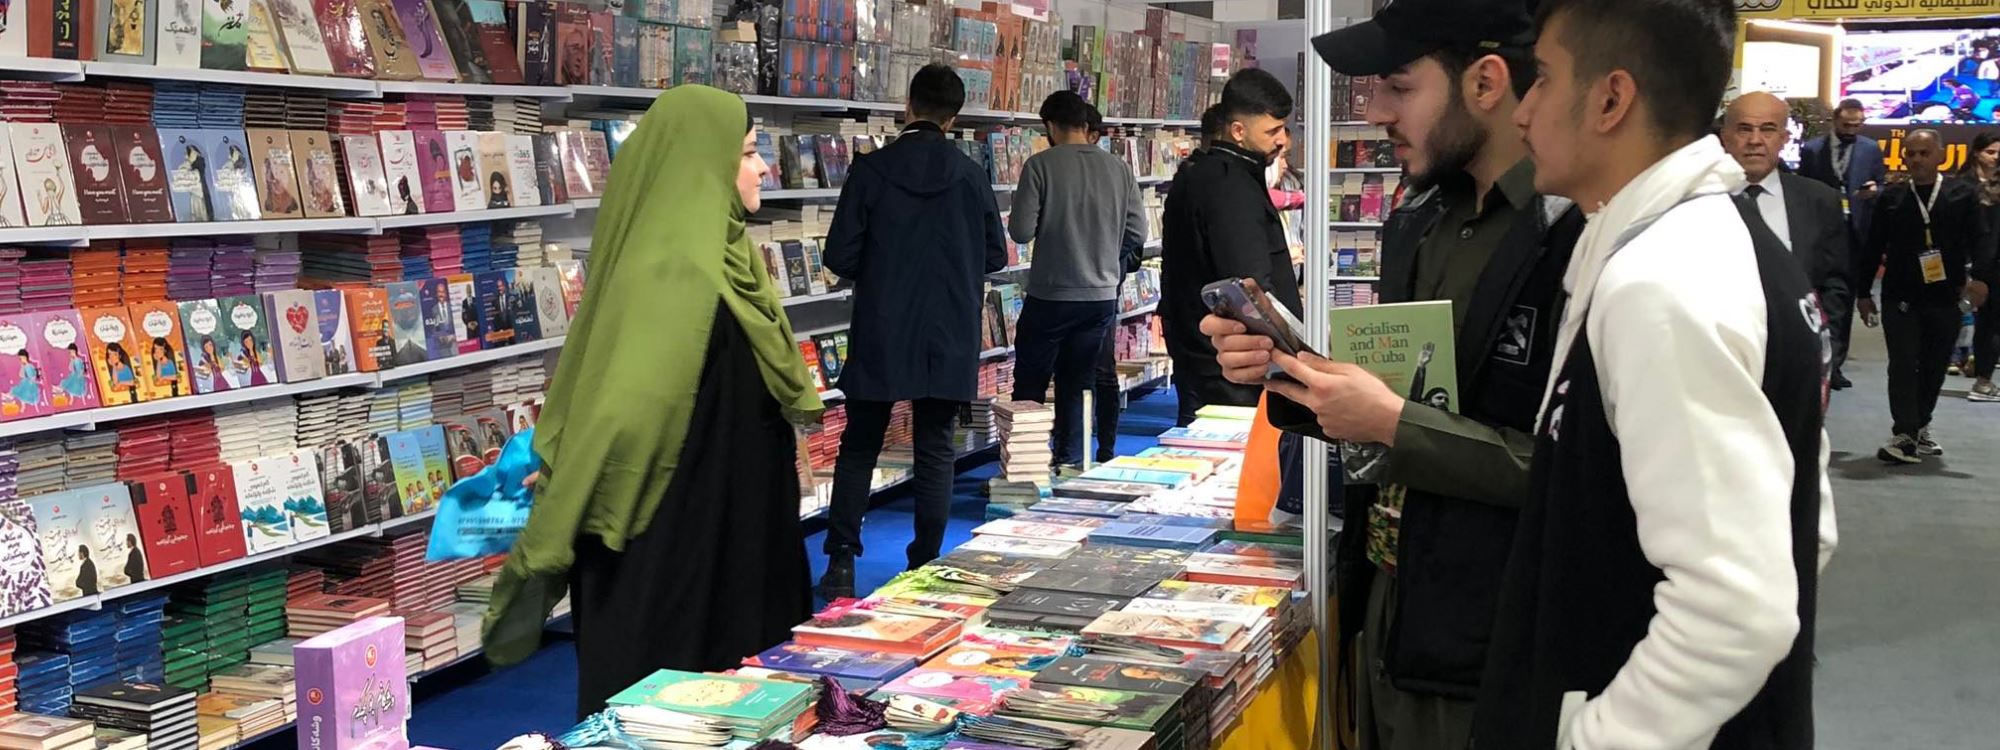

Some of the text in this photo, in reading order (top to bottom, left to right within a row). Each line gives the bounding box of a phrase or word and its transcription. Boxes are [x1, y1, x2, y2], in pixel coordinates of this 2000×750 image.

[1346, 321, 1410, 337] Socialism
[1350, 336, 1409, 351] and Man
[1355, 350, 1406, 365] in Cuba
